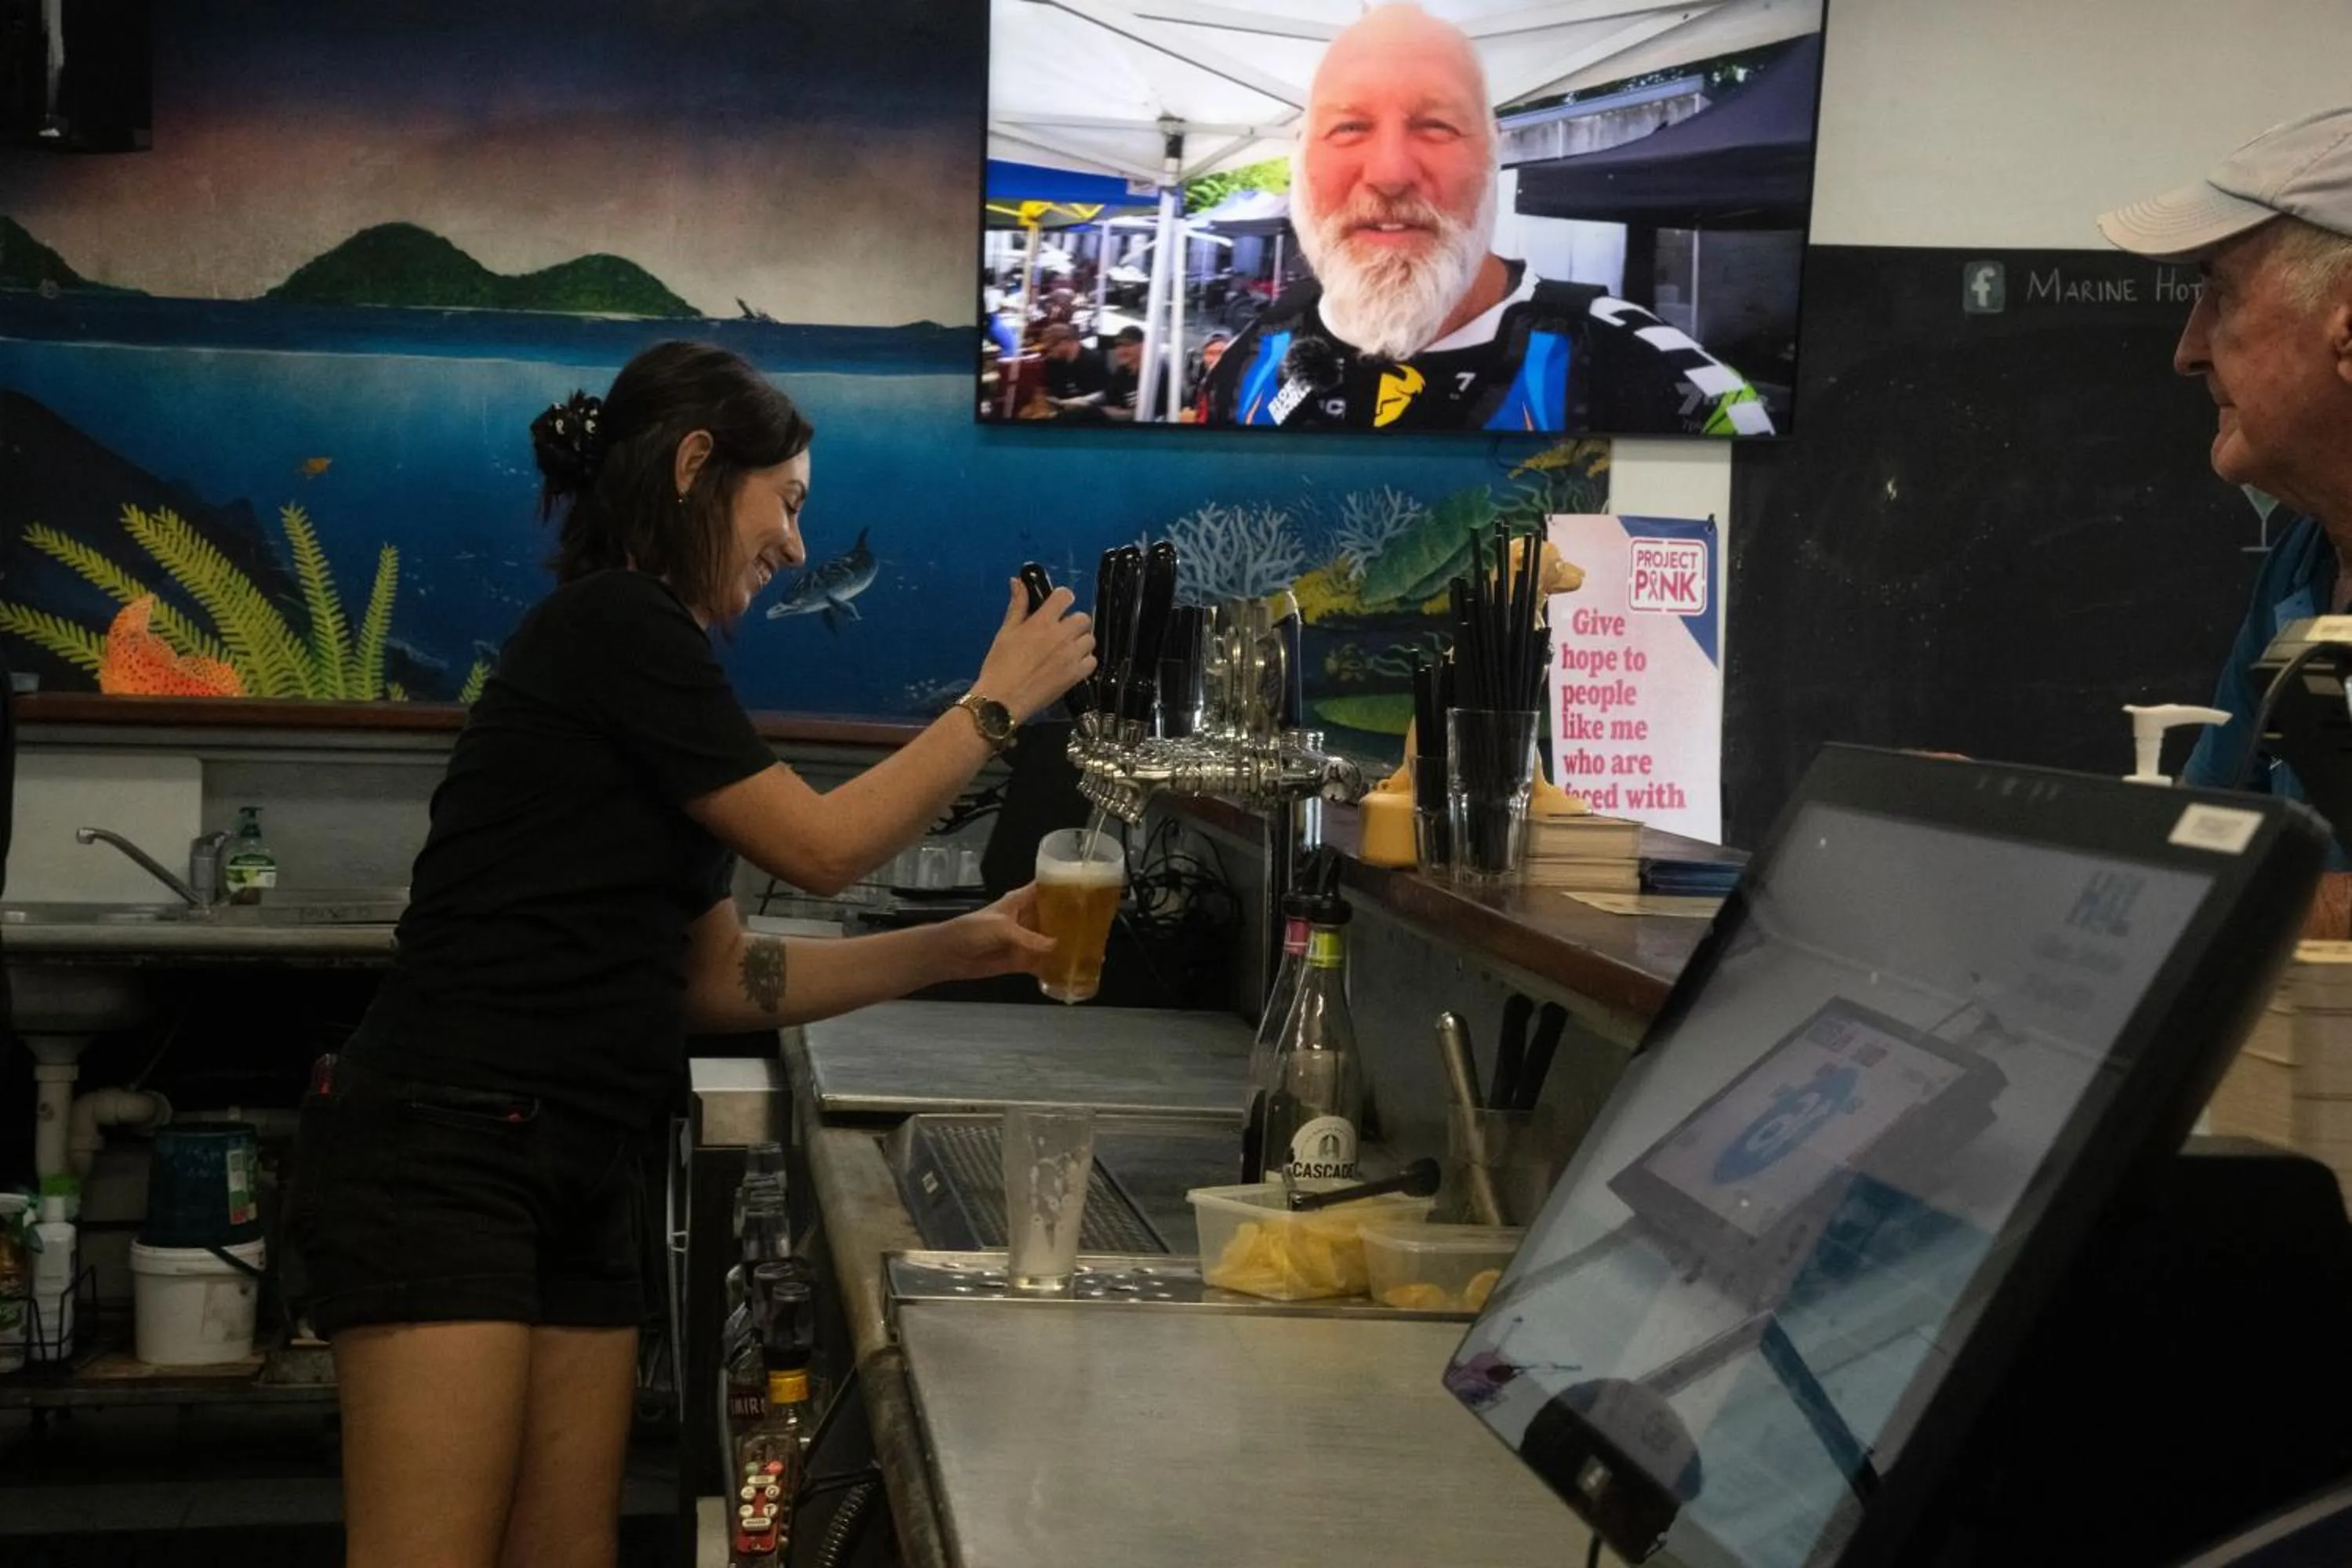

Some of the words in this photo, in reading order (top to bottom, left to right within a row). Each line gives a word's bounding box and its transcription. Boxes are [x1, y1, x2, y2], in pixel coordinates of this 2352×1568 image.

[2027, 267, 2139, 303] MARINE
[1635, 550, 1699, 569] PROJECT
[1572, 608, 1625, 637] Give
[1561, 642, 1617, 677] hope
[1624, 644, 1647, 673] to
[1561, 681, 1637, 713] people
[1561, 713, 1604, 741] like
[1610, 720, 1649, 741] me
[1562, 748, 1606, 775] who
[1611, 754, 1653, 775] are
[1624, 781, 1687, 809] with
[1293, 1161, 1356, 1179] CASCADE
